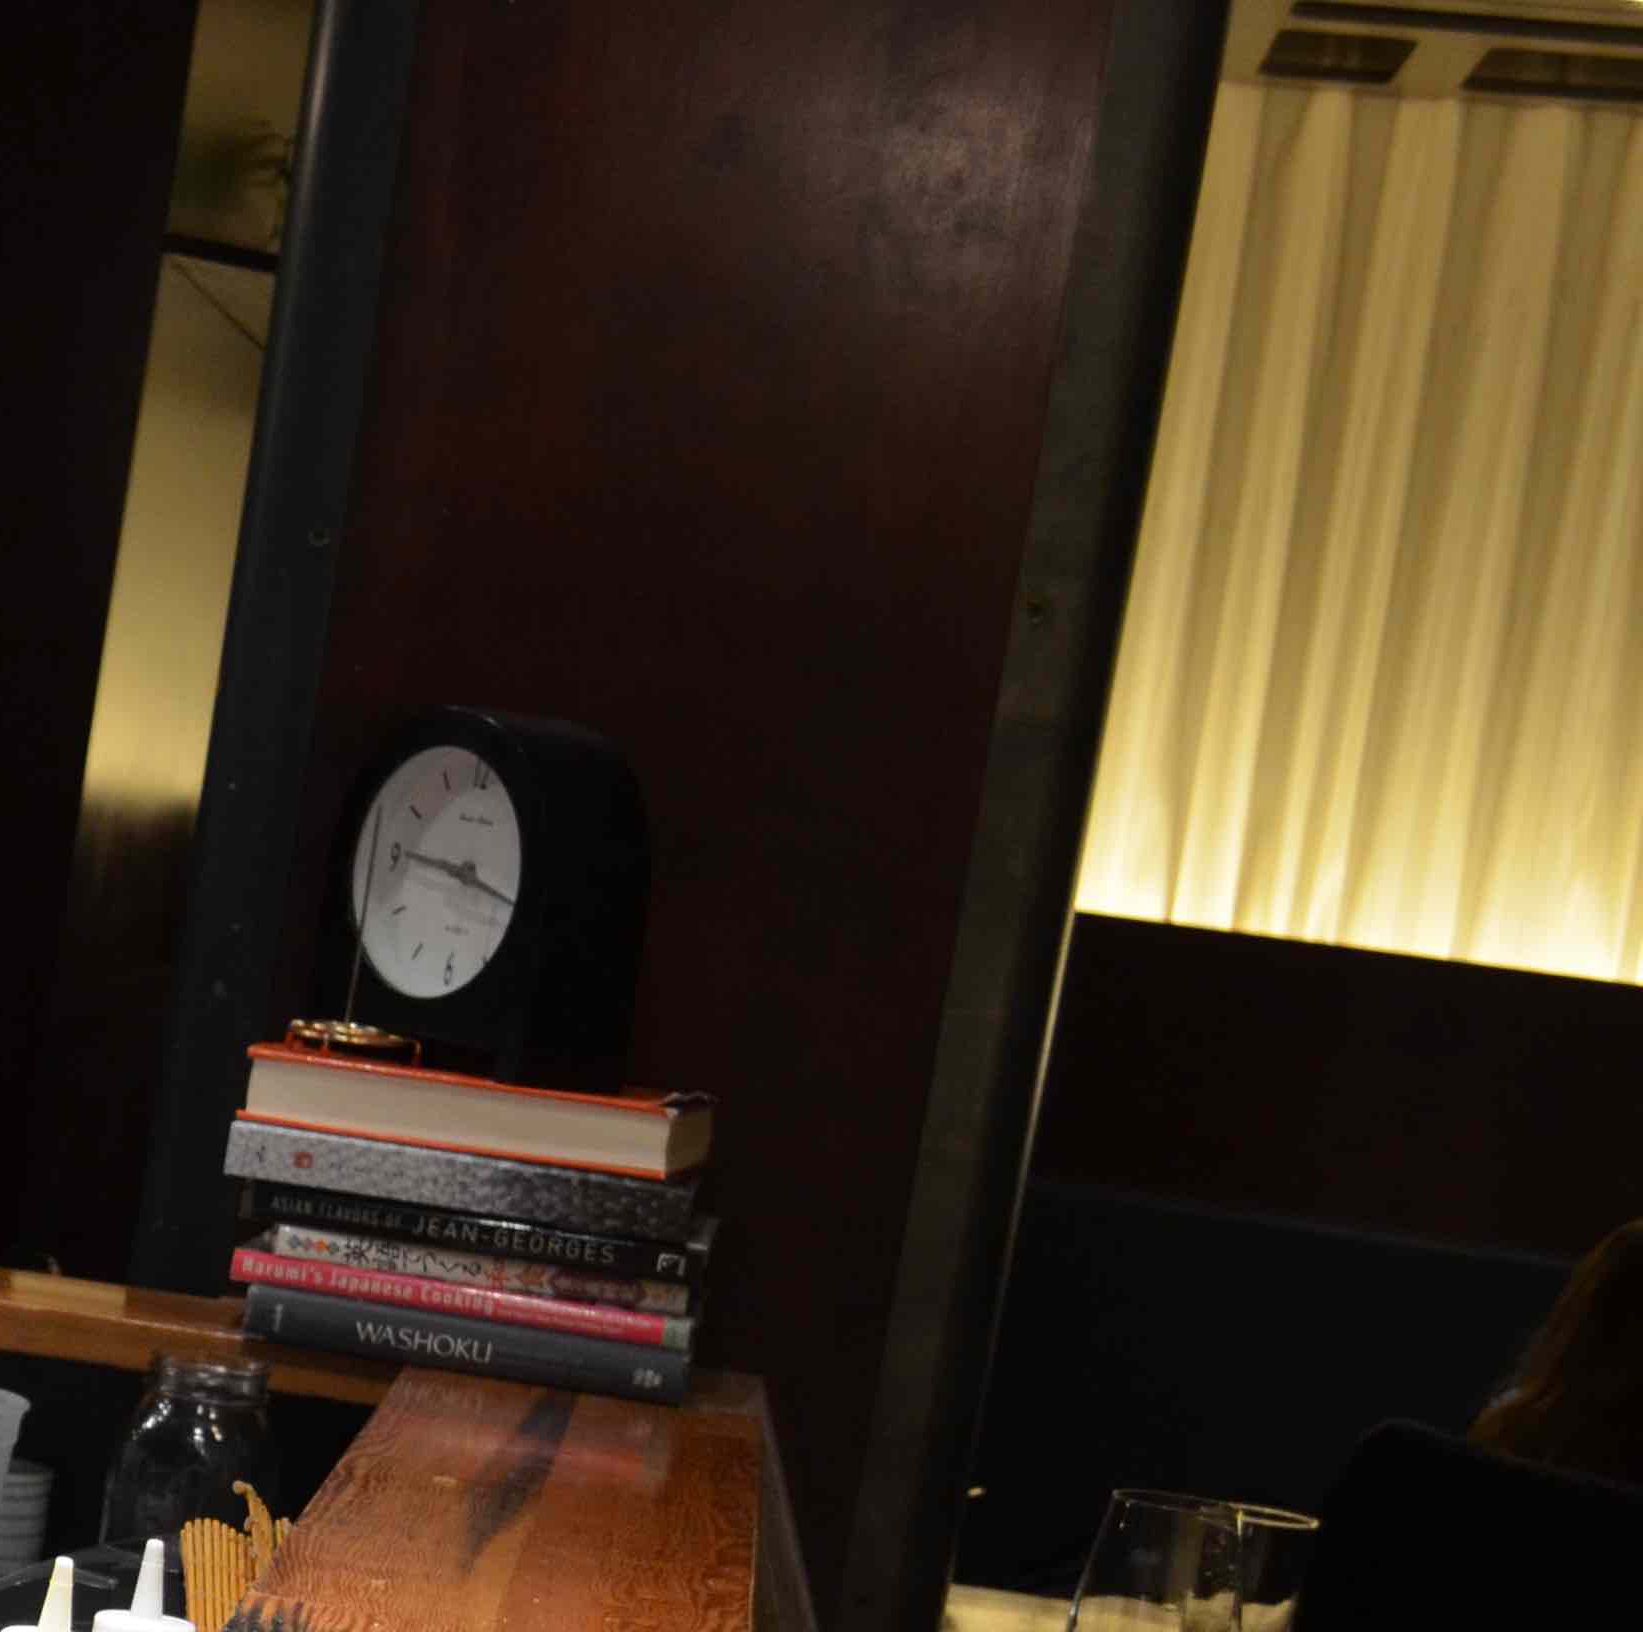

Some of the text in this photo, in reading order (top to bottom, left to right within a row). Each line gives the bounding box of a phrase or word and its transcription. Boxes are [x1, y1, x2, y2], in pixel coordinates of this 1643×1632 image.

[412, 1215, 615, 1264] JEAN-GEORGES
[331, 1267, 414, 1297] Japanese
[420, 1284, 495, 1314] Cooking
[355, 1320, 493, 1364] WASHOKU
